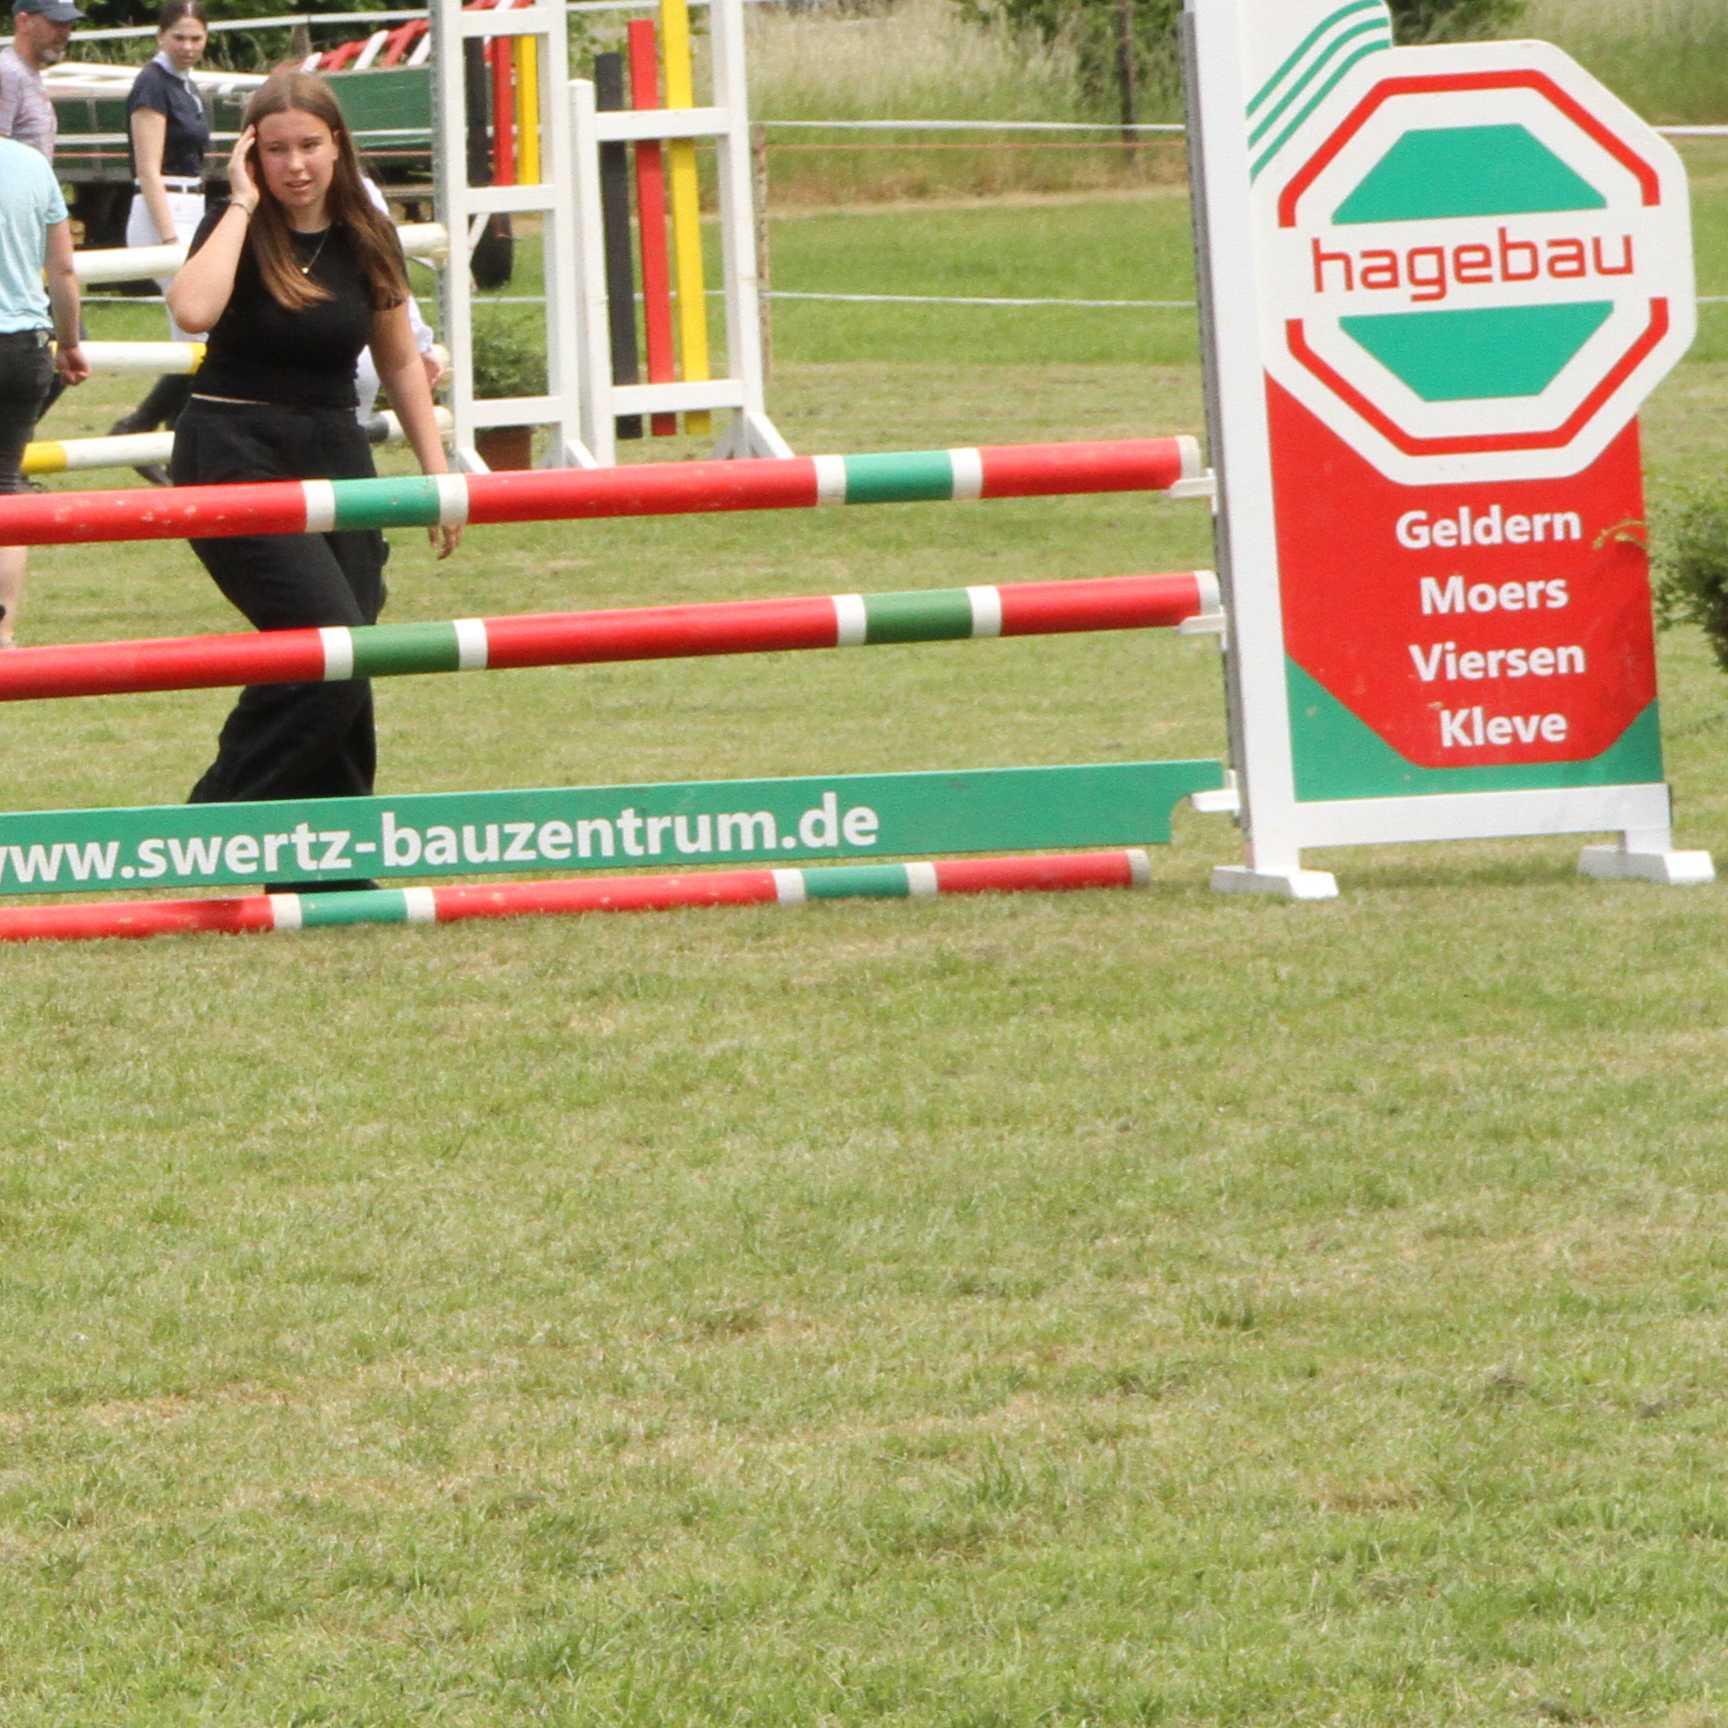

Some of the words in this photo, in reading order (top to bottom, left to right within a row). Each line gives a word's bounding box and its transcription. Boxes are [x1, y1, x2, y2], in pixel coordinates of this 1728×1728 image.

[1311, 227, 1634, 303] hagebau
[1395, 504, 1582, 550] Geldern
[1419, 574, 1569, 616] Moers
[1408, 640, 1586, 682] Viersen
[1439, 705, 1568, 748] Kleve
